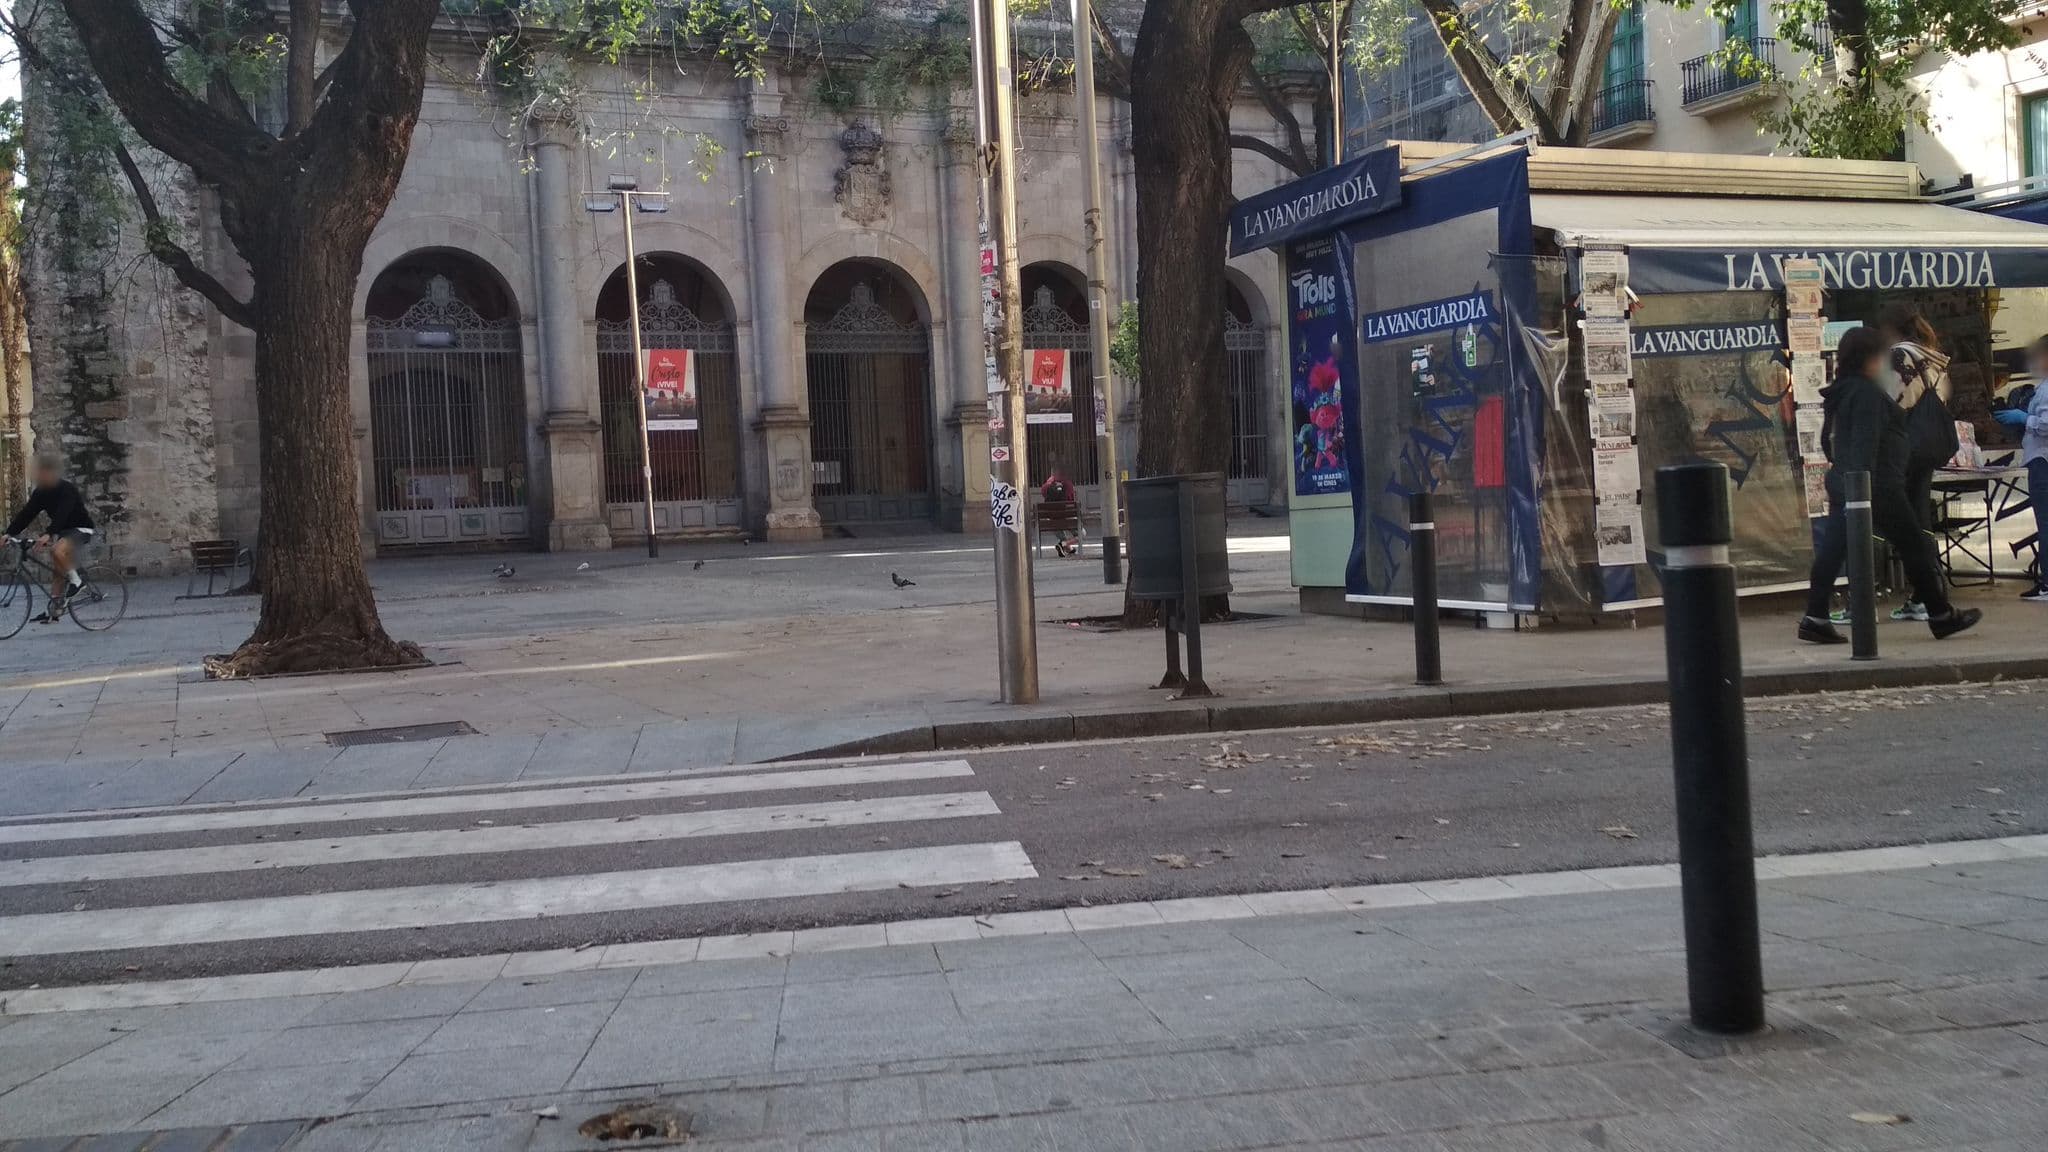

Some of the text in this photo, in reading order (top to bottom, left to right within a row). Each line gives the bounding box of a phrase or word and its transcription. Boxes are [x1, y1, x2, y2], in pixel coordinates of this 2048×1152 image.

[1243, 172, 1378, 238] LA VANGUARDIA
[1724, 250, 1997, 291] LA VNGUARDIA
[1368, 296, 1488, 338] LA VANGUARDIA
[1630, 323, 1782, 354] LA VANGUARDIA
